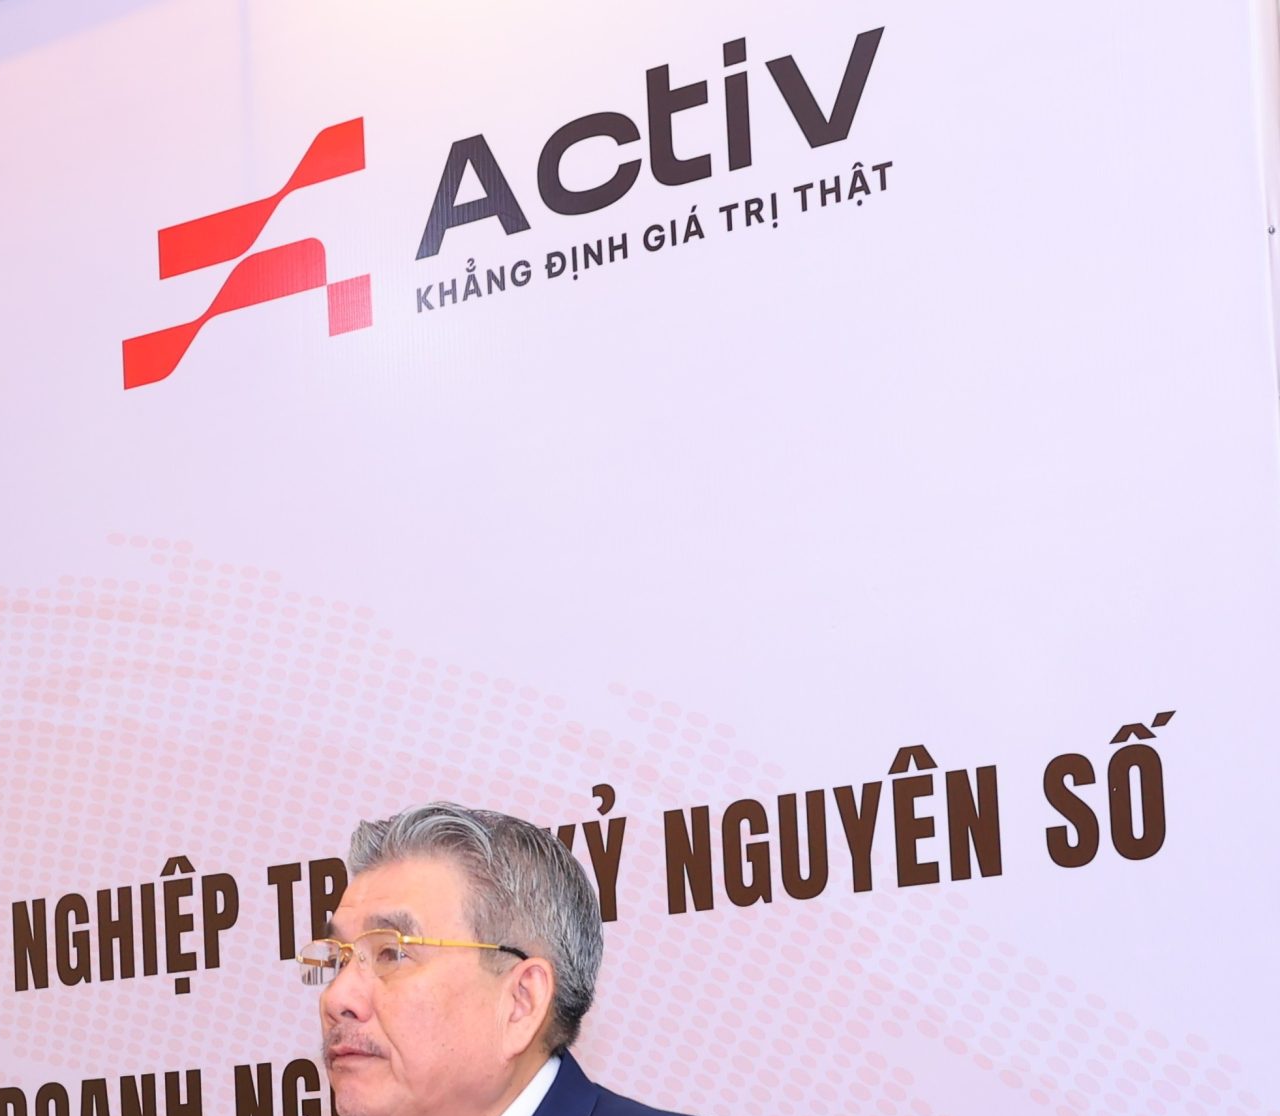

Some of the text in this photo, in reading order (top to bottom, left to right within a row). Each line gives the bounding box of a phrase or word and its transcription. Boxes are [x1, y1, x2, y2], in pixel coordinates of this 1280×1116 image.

[415, 26, 886, 262] Activ
[417, 161, 893, 313] KHẲNG ĐỊNH GIÁ TRỊ THẬT
[12, 855, 239, 995] NGHIỆP
[540, 783, 627, 922] Ỷ
[663, 744, 1003, 915] NGUYÊN
[1043, 710, 1176, 868] SỐ
